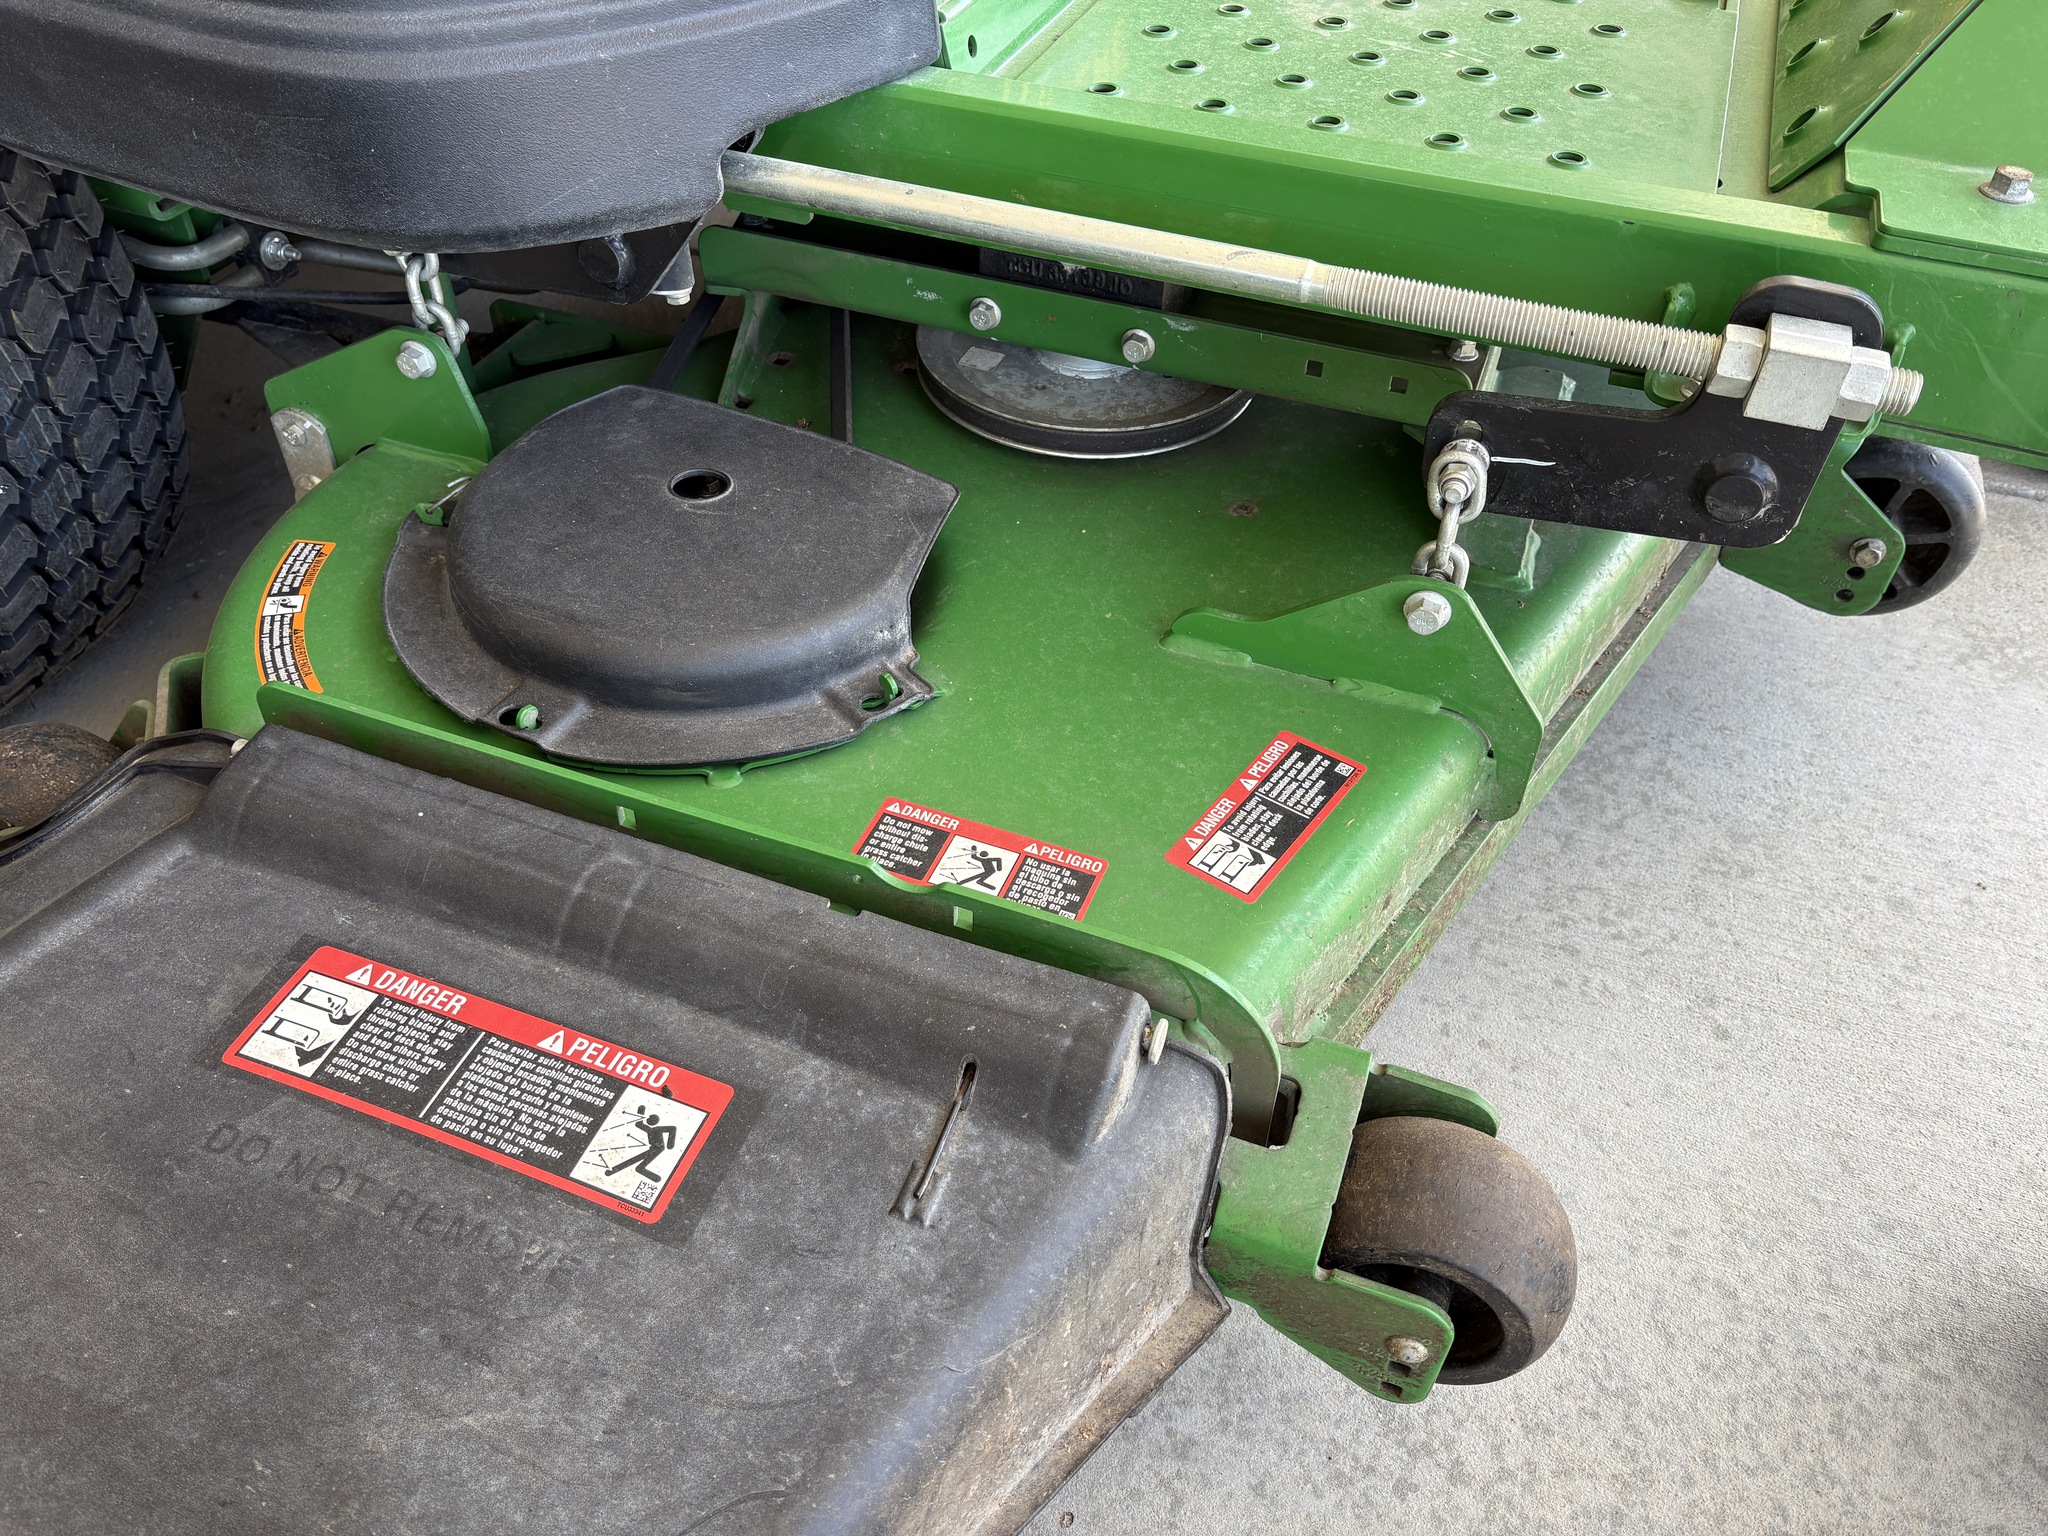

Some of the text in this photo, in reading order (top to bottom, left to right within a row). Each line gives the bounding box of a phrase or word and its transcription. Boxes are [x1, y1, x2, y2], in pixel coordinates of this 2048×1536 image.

[303, 560, 322, 587] WARNING
[294, 636, 313, 677] ADVERTENCIA
[1247, 740, 1289, 778] PELIGRO
[882, 815, 933, 836] Do not mow
[900, 804, 959, 830] DANGER
[1193, 797, 1236, 836] DANGER
[1222, 795, 1261, 832] To avoid injury
[1231, 804, 1267, 837] from rotating
[1240, 810, 1274, 841] blades, stay
[1251, 812, 1283, 846] clear of deck
[873, 830, 928, 852] charge chute
[878, 823, 928, 842] without dis-
[879, 841, 906, 853] entire
[1260, 836, 1277, 850] edge.
[862, 845, 922, 867] grass catcher
[1025, 857, 1070, 876] No usar la
[1038, 845, 1102, 872] PELIGRO
[1011, 884, 1022, 892] el
[1015, 877, 1080, 902] descarga o sin
[1015, 884, 1069, 906] recogedor
[1029, 873, 1049, 885] tubo
[1051, 880, 1063, 889] de
[1062, 877, 1076, 886] sin
[1008, 889, 1020, 899] de
[1021, 894, 1047, 907] pasto
[1048, 903, 1061, 911] en
[373, 970, 467, 1015] DANGER
[366, 1013, 453, 1050] thrown objects, stay
[373, 1006, 457, 1040] rotating blades and
[380, 997, 465, 1033] To avoid injury from
[345, 1037, 432, 1074] Do not mow without
[352, 1030, 446, 1070] and keep others away.
[359, 1022, 438, 1055] clear of deck edge
[324, 1063, 361, 1084] in place.
[331, 1056, 419, 1092] entire grass catcher
[338, 1047, 419, 1081] discharge chute or
[481, 1046, 615, 1099] causadas por cuchillas giratorias
[487, 1036, 603, 1084] Para evitar sufrir lesiones
[566, 1036, 670, 1087] PELIGRO
[461, 1070, 593, 1124] plataforma de corte y mantener
[468, 1062, 572, 1105] alejado del borde de la
[474, 1054, 606, 1107] y objetos lanzados, mantenerse
[443, 1096, 546, 1141] máquina sin el tubo de
[449, 1087, 566, 1137] de la máquina. No usar la
[463, 1080, 478, 1092] las
[478, 1087, 508, 1103] demás
[506, 1099, 548, 1119] personas
[548, 1114, 588, 1133] alejadas
[430, 1114, 523, 1156] de pasto en su lugar.
[436, 1105, 478, 1126] descarga
[487, 1125, 503, 1136] sin
[503, 1131, 515, 1140] el
[515, 1135, 563, 1158] recogedor
[204, 1121, 270, 1165] DO
[278, 1150, 379, 1204] NOT
[617, 1202, 645, 1217] TCU33341
